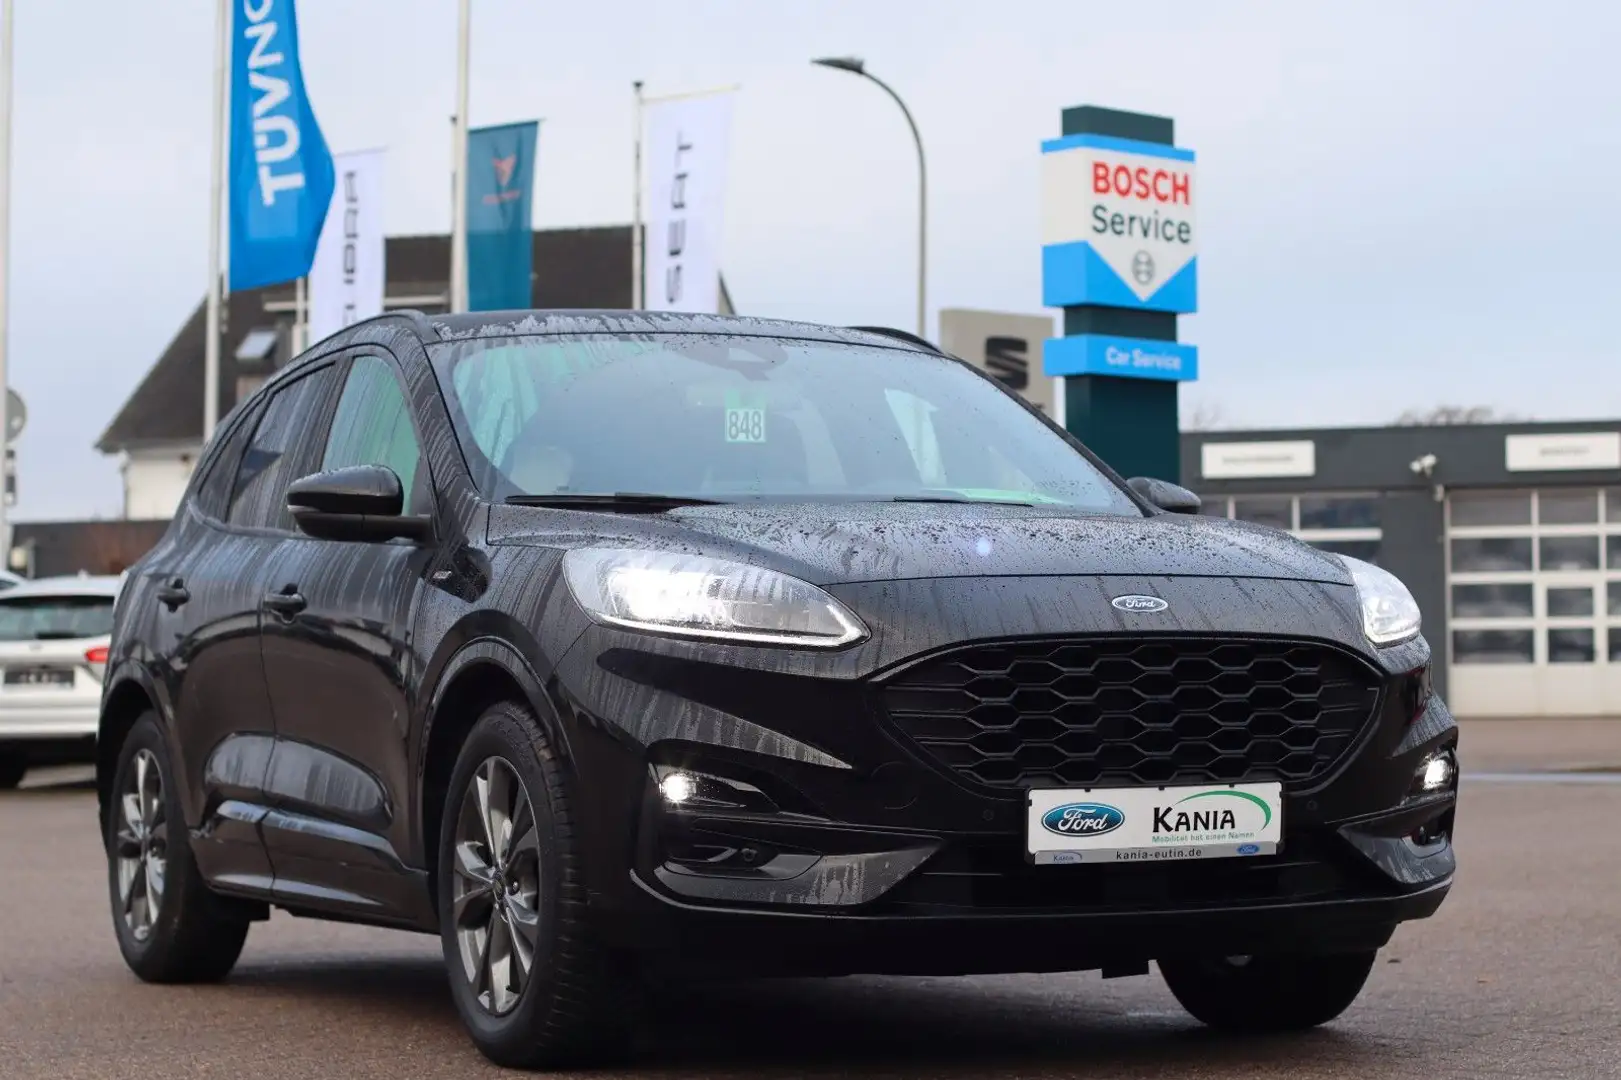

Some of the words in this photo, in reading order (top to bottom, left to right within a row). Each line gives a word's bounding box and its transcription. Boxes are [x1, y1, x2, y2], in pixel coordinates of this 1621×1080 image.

[1091, 161, 1191, 205] BOSCH
[1091, 204, 1192, 244] Service
[1105, 346, 1130, 366] Car
[1132, 348, 1182, 371] Service
[728, 410, 762, 440] 848
[1126, 598, 1156, 608] Ford
[1057, 808, 1109, 831] Ford
[1116, 848, 1202, 860] kania-eutin.de
